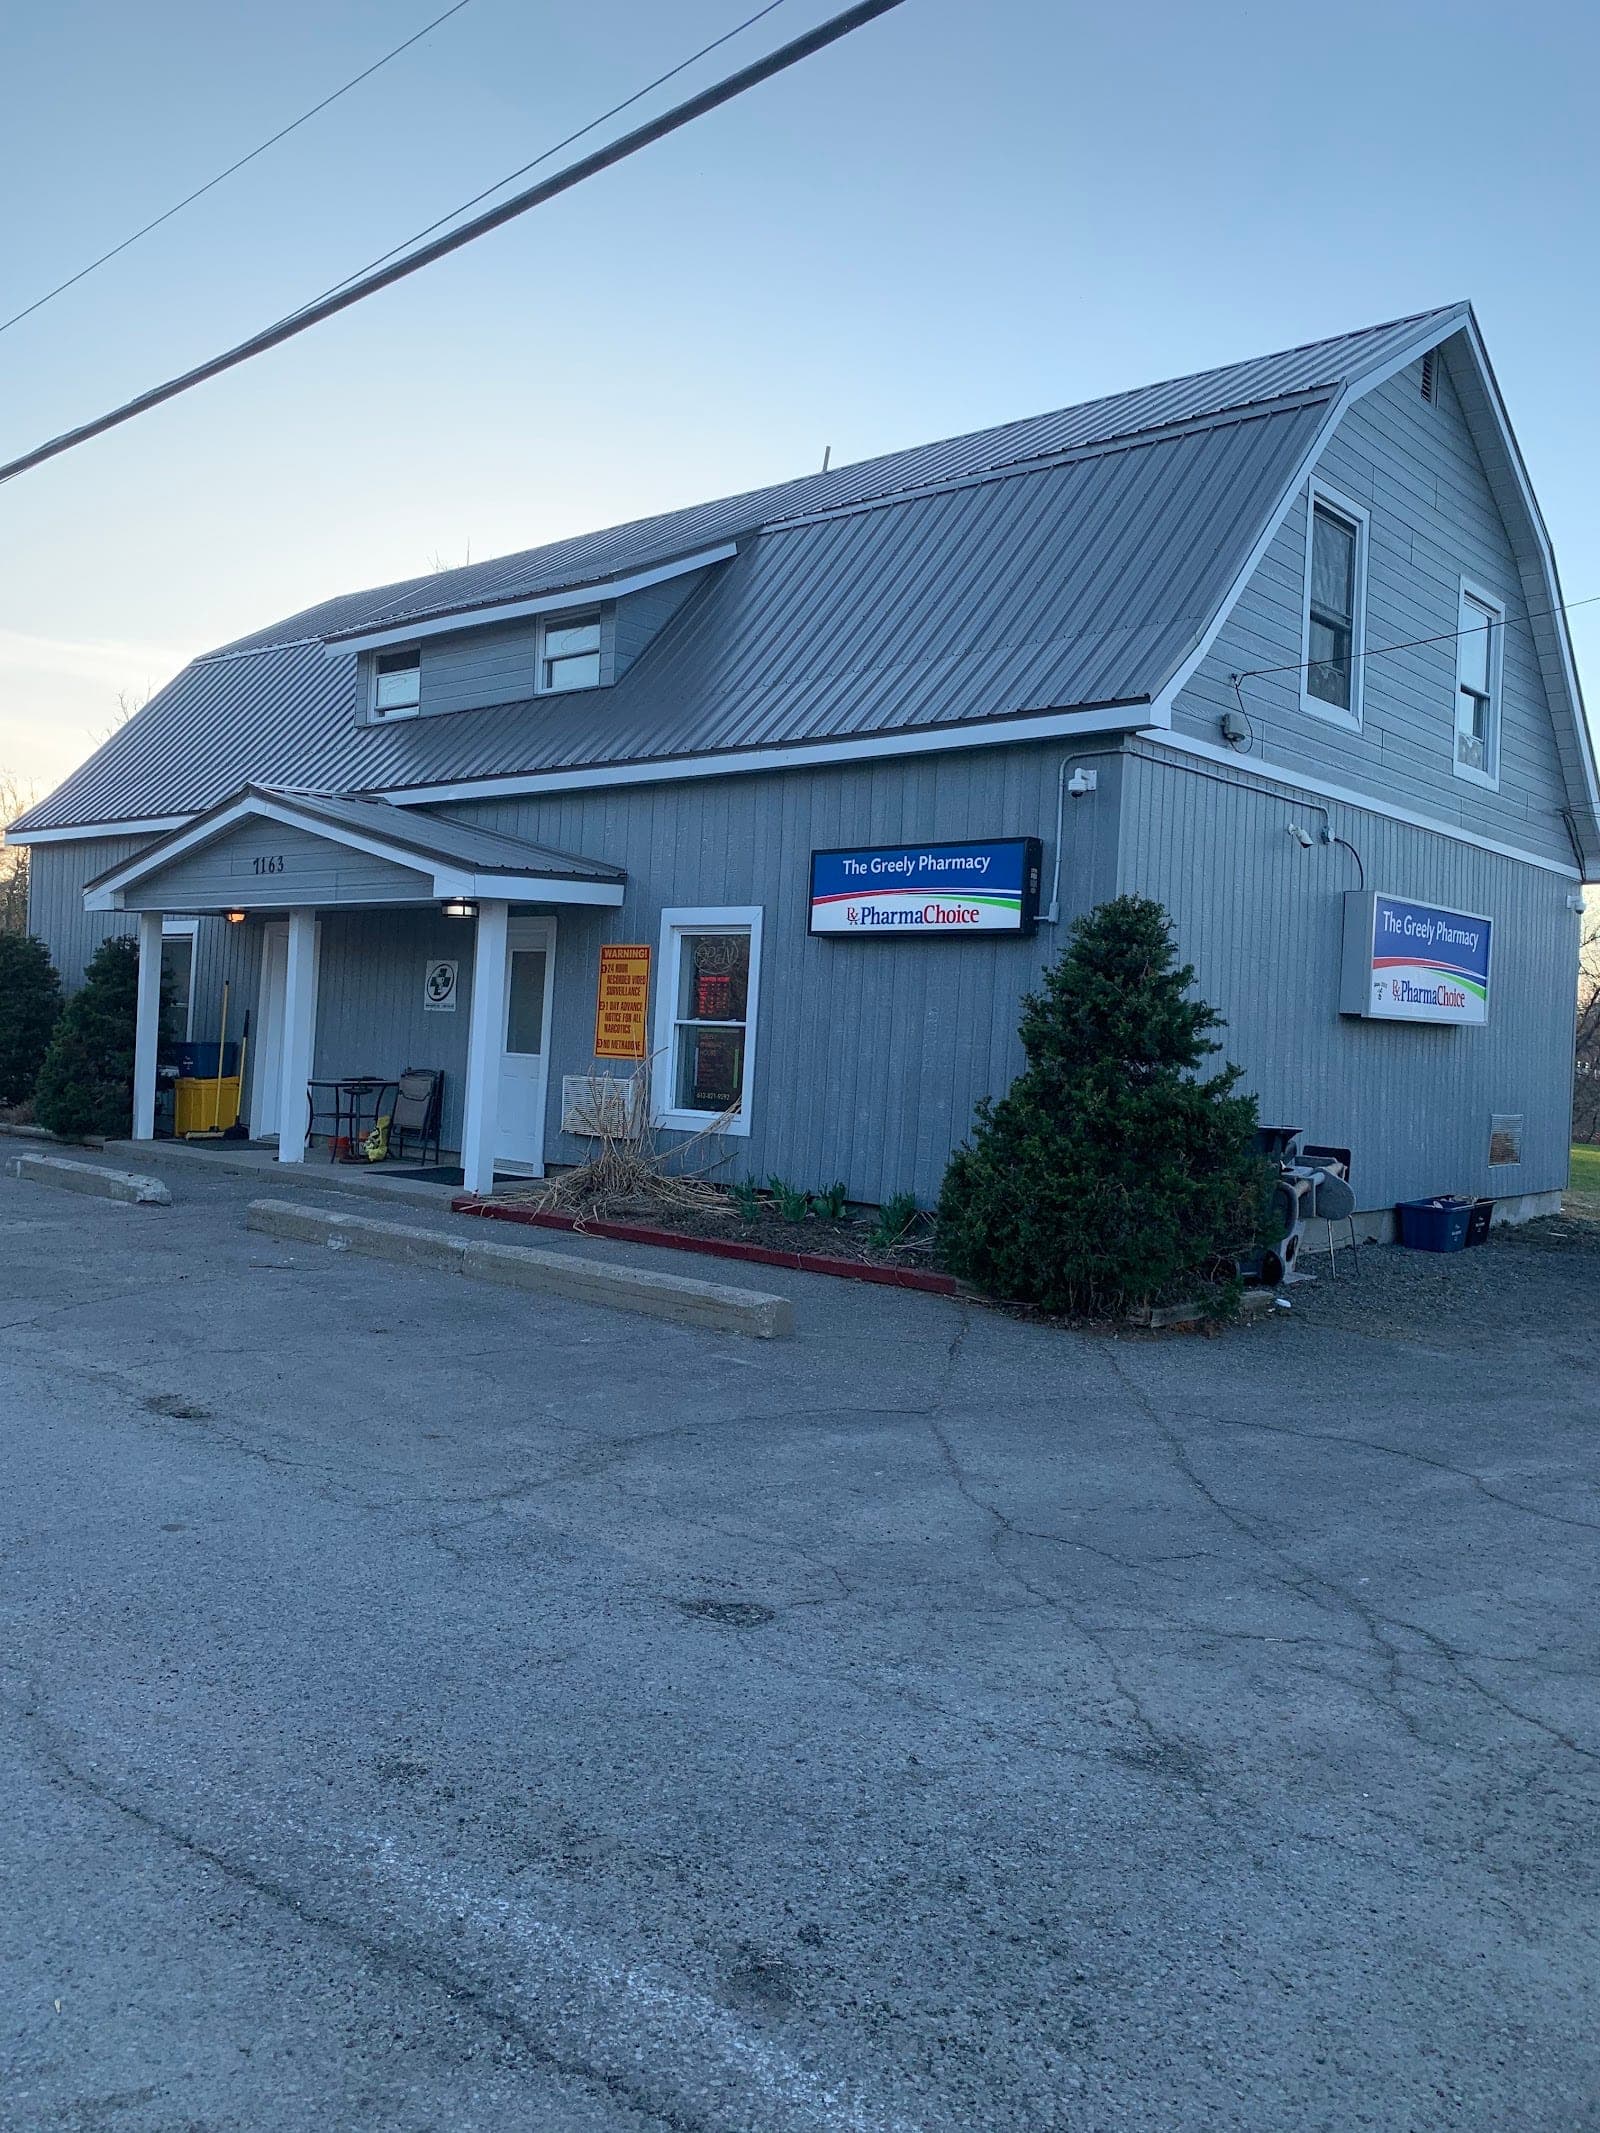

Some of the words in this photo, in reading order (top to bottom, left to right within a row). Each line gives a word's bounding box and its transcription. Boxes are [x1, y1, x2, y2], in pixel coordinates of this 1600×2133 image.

[842, 859, 868, 876] The
[870, 855, 916, 877] Greely
[918, 854, 991, 874] Pharmacy
[1383, 910, 1401, 933] The
[1403, 915, 1436, 945] Greely
[1436, 921, 1479, 952] Pharmacy
[604, 948, 648, 959] WARNING!
[607, 963, 615, 973] 24
[606, 986, 641, 996] SURVEILLANCE
[620, 1001, 643, 1012] ADVANCE
[632, 1013, 642, 1024] ALL
[603, 1023, 631, 1034] NARCOTICS
[602, 1039, 611, 1049] NO
[611, 1040, 641, 1051] METHADONE
